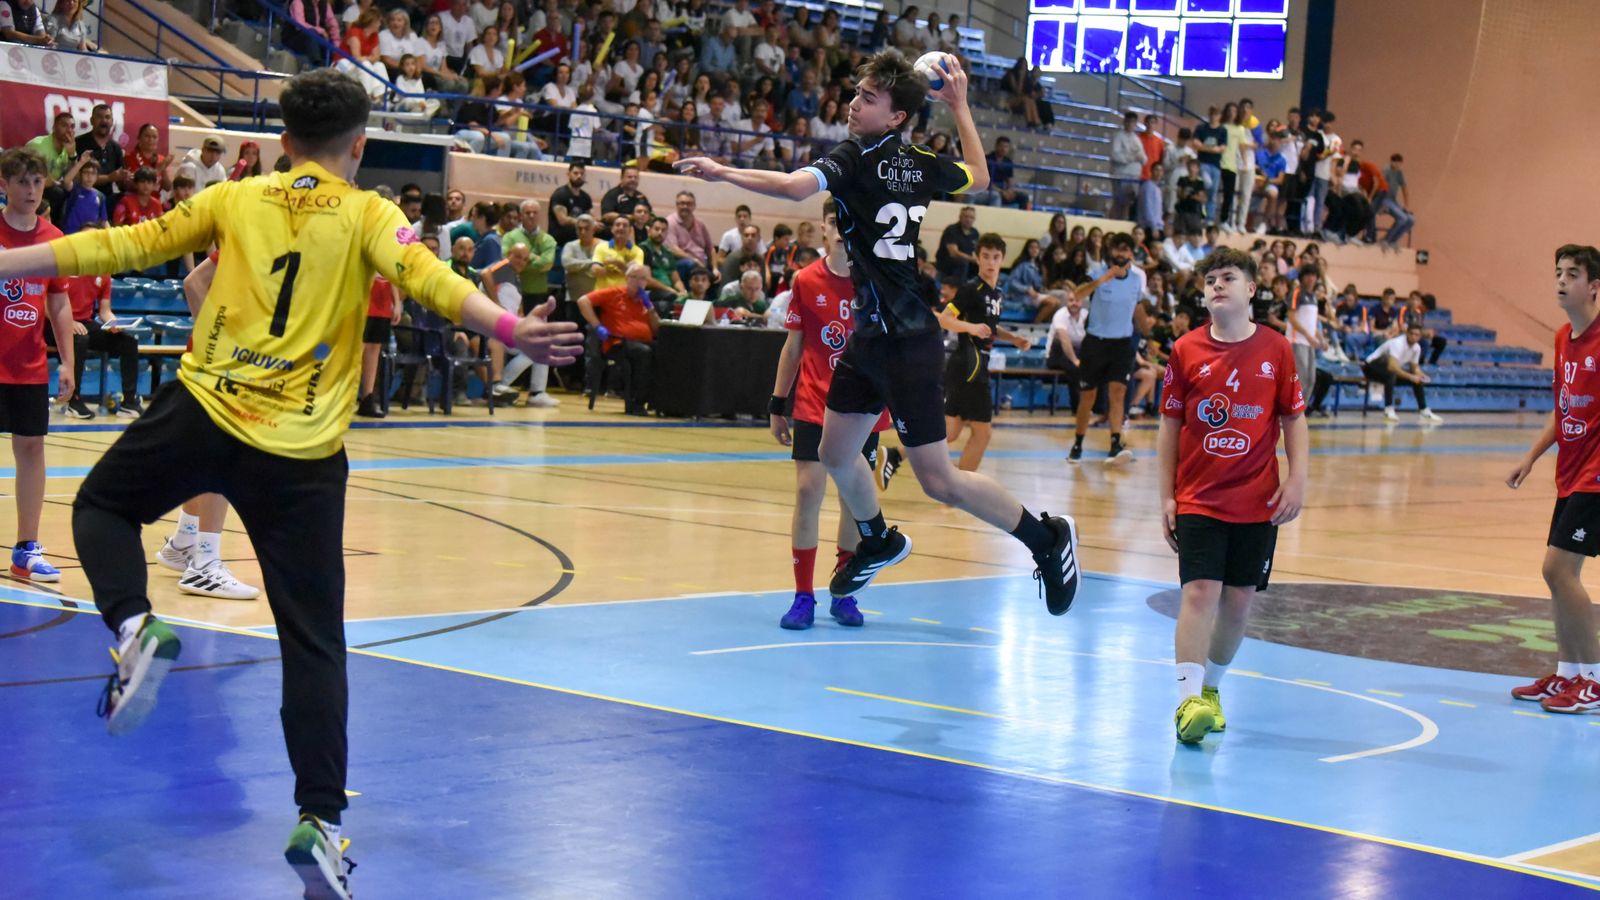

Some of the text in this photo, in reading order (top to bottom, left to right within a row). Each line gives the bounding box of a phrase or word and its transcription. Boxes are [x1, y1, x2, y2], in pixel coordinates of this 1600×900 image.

[269, 250, 301, 338] 1
[208, 306, 227, 341] Kappa
[1226, 368, 1240, 392] 4
[1564, 361, 1578, 384] 87
